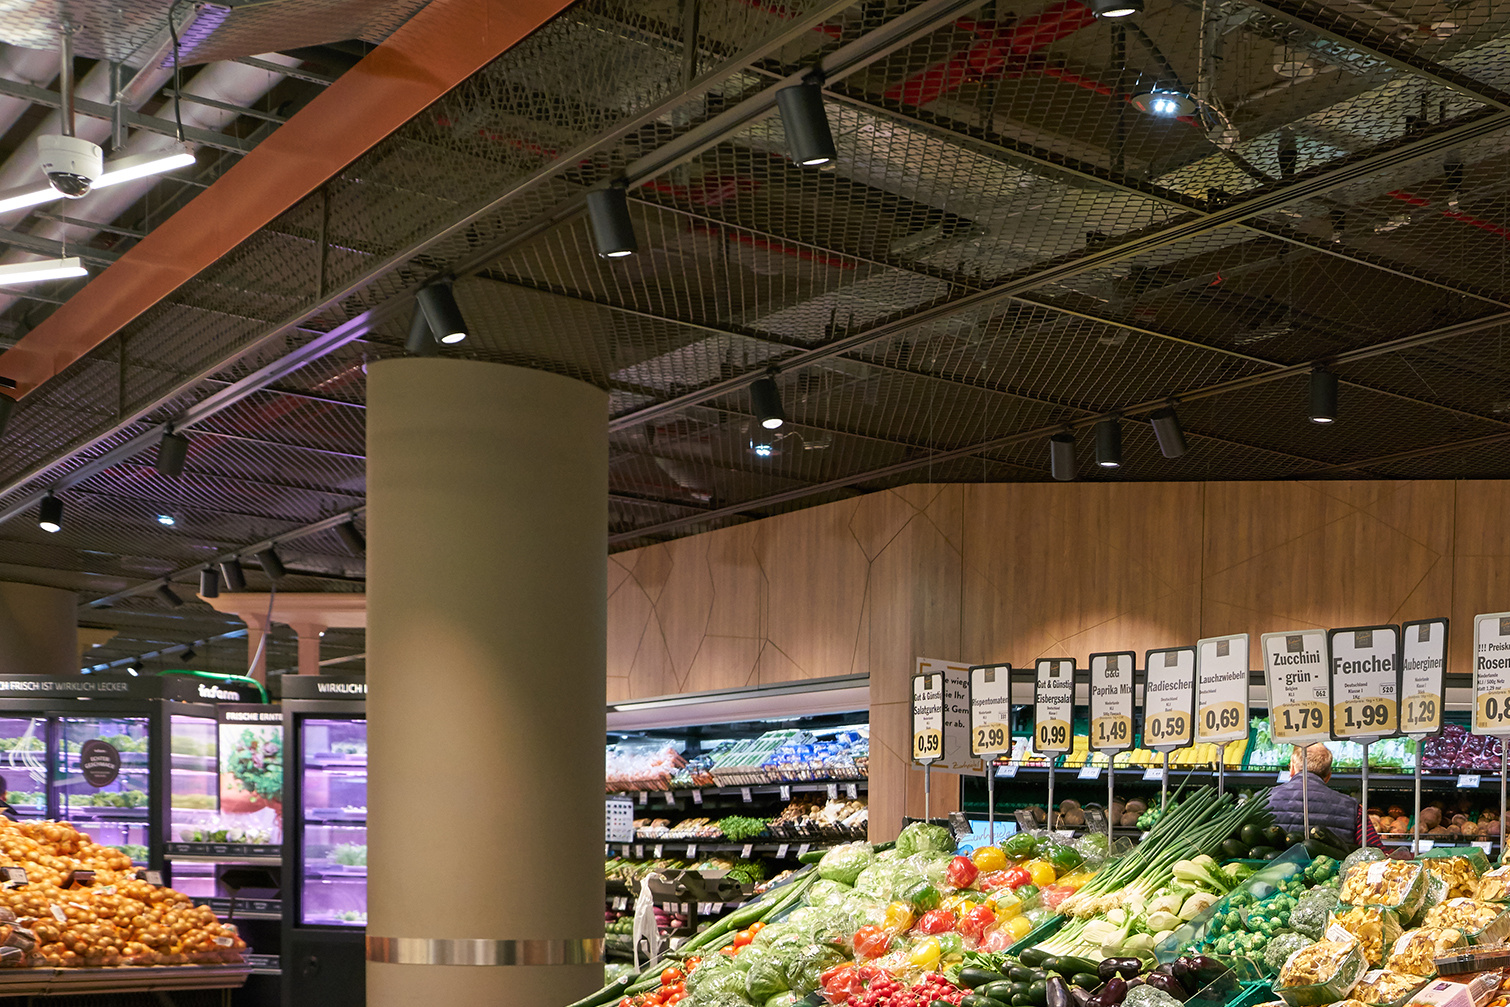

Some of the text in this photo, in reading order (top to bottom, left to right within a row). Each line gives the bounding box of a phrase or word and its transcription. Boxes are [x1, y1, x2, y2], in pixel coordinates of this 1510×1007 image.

[1273, 650, 1321, 666] Zucchini
[1333, 654, 1397, 675] Fenchel
[1053, 680, 1072, 690] Günstig
[1147, 679, 1194, 692] Radieschen
[1200, 670, 1246, 685] Lauchzwiebeln
[1285, 670, 1311, 686] grün
[10, 682, 129, 691] FRISCH IST WIRKLICH LECKER
[317, 683, 362, 694] WIRKLICH
[1093, 685, 1118, 697] Paprika
[954, 691, 965, 700] Ihr
[226, 712, 259, 721] FRISCHE
[1206, 708, 1240, 731] 0,69
[1283, 708, 1323, 732] 1,79
[1344, 704, 1388, 729] 1,99
[1407, 700, 1436, 724] 1,29
[1041, 726, 1066, 745] 0,99
[1099, 721, 1127, 742] 1,49
[1152, 717, 1185, 739] 0,59
[918, 734, 939, 753] 0,59
[978, 728, 1004, 748] 2,99
